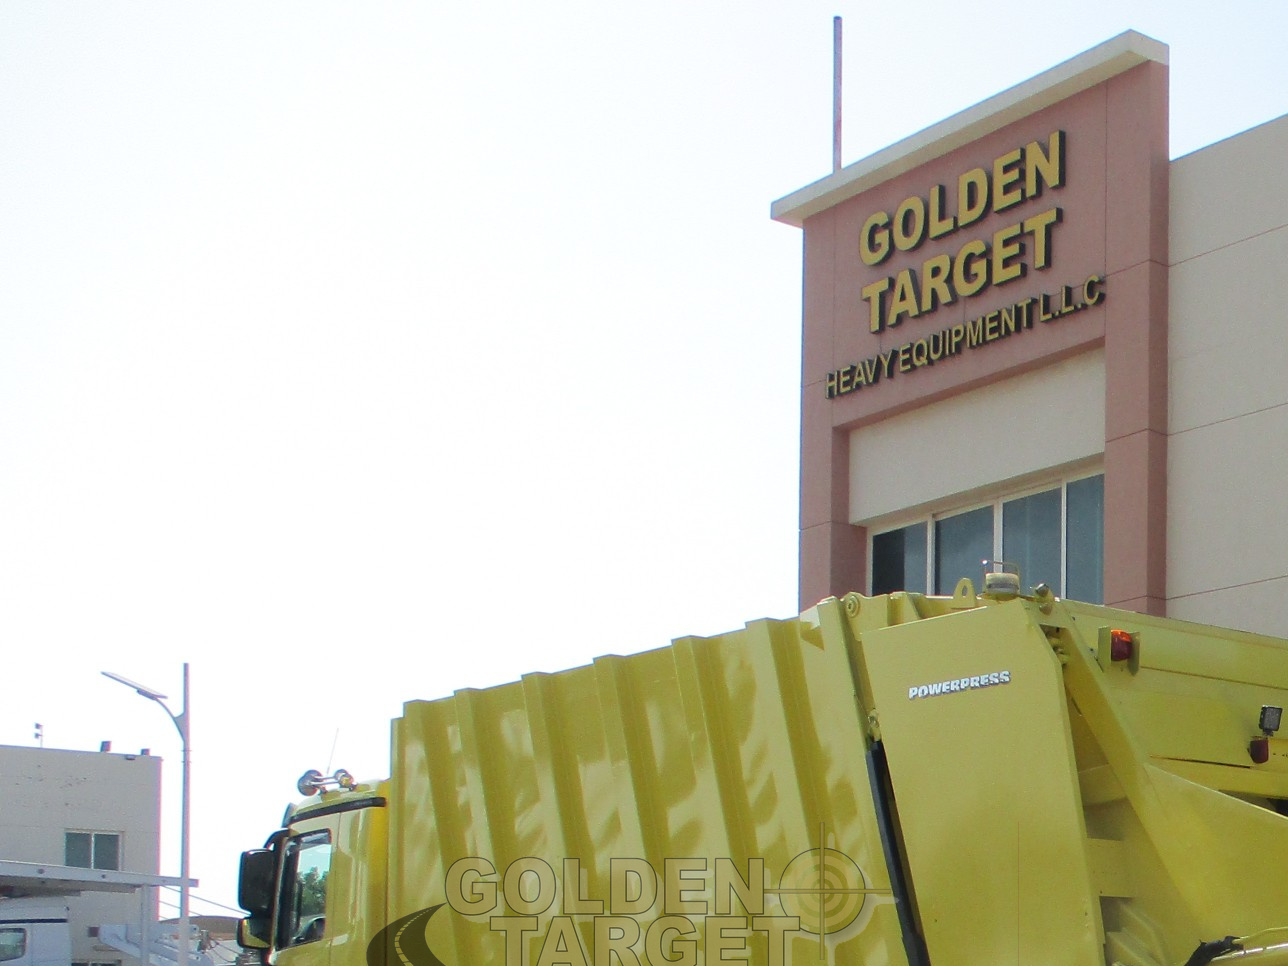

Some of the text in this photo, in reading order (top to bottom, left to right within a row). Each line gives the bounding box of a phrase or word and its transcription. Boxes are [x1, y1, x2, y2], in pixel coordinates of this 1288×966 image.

[858, 129, 1065, 266] GOLDEN
[861, 208, 1061, 334] TARGET
[825, 275, 1105, 399] HEAVY EQUIPMENT L.L.C
[908, 670, 1011, 700] POWERPRESS
